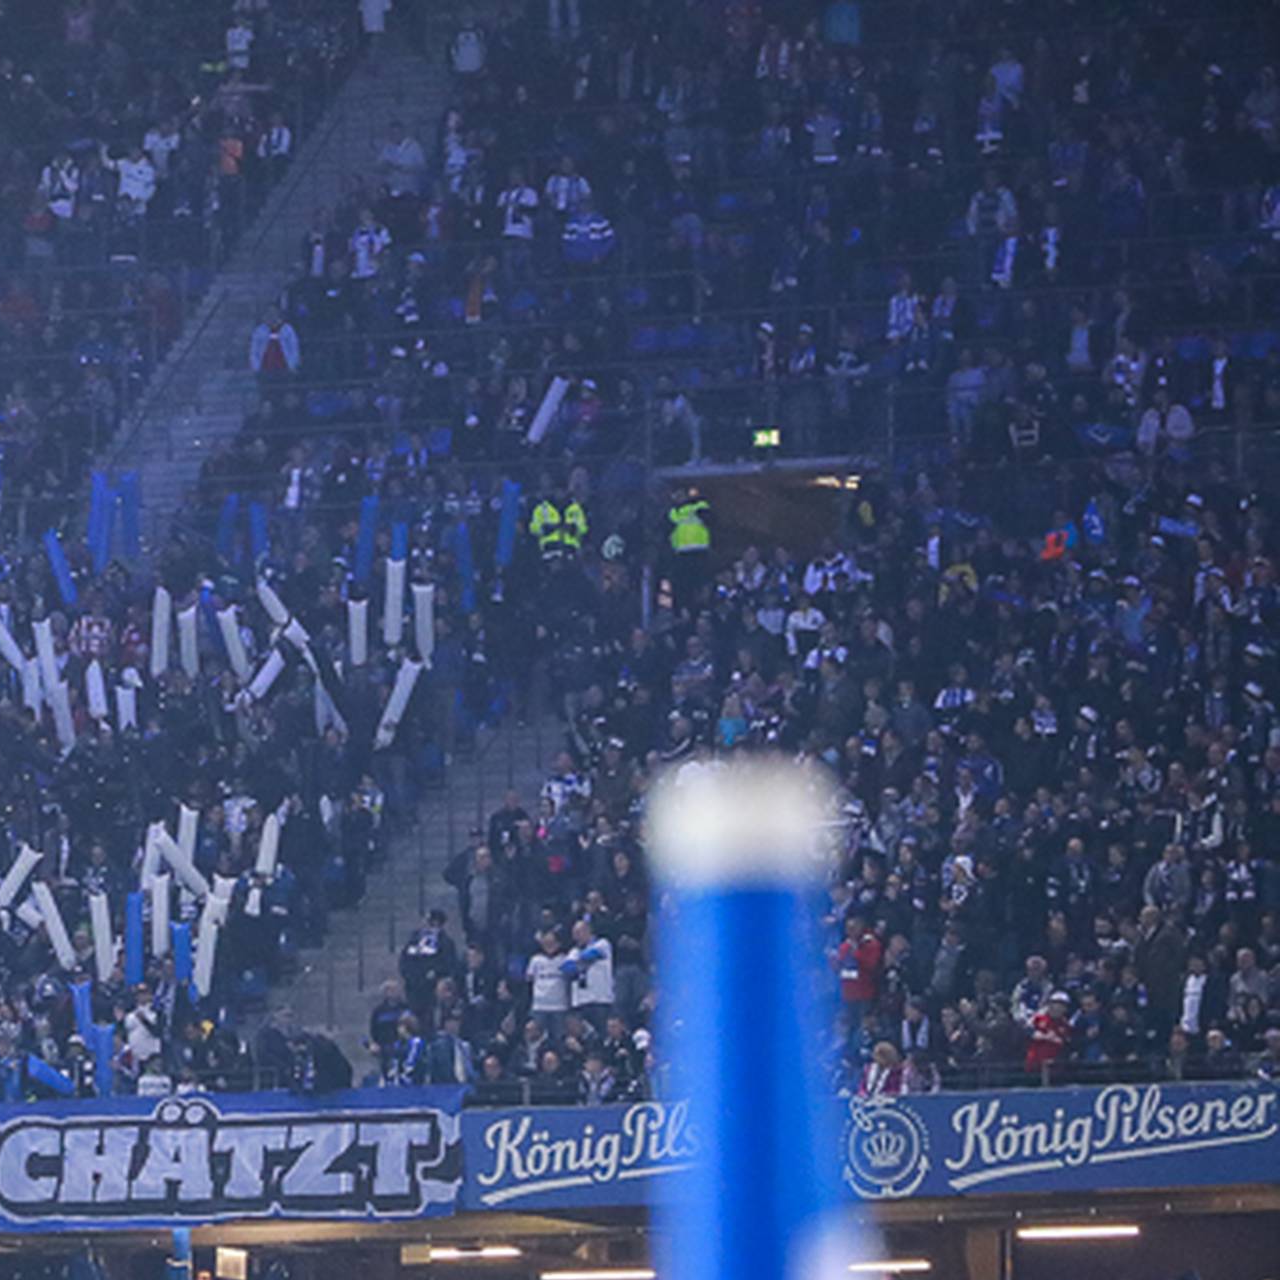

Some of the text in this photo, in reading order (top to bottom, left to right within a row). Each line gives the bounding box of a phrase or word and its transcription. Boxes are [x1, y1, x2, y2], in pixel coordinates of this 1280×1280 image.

[477, 1116, 620, 1183] König
[944, 1083, 1277, 1172] König Pilsener
